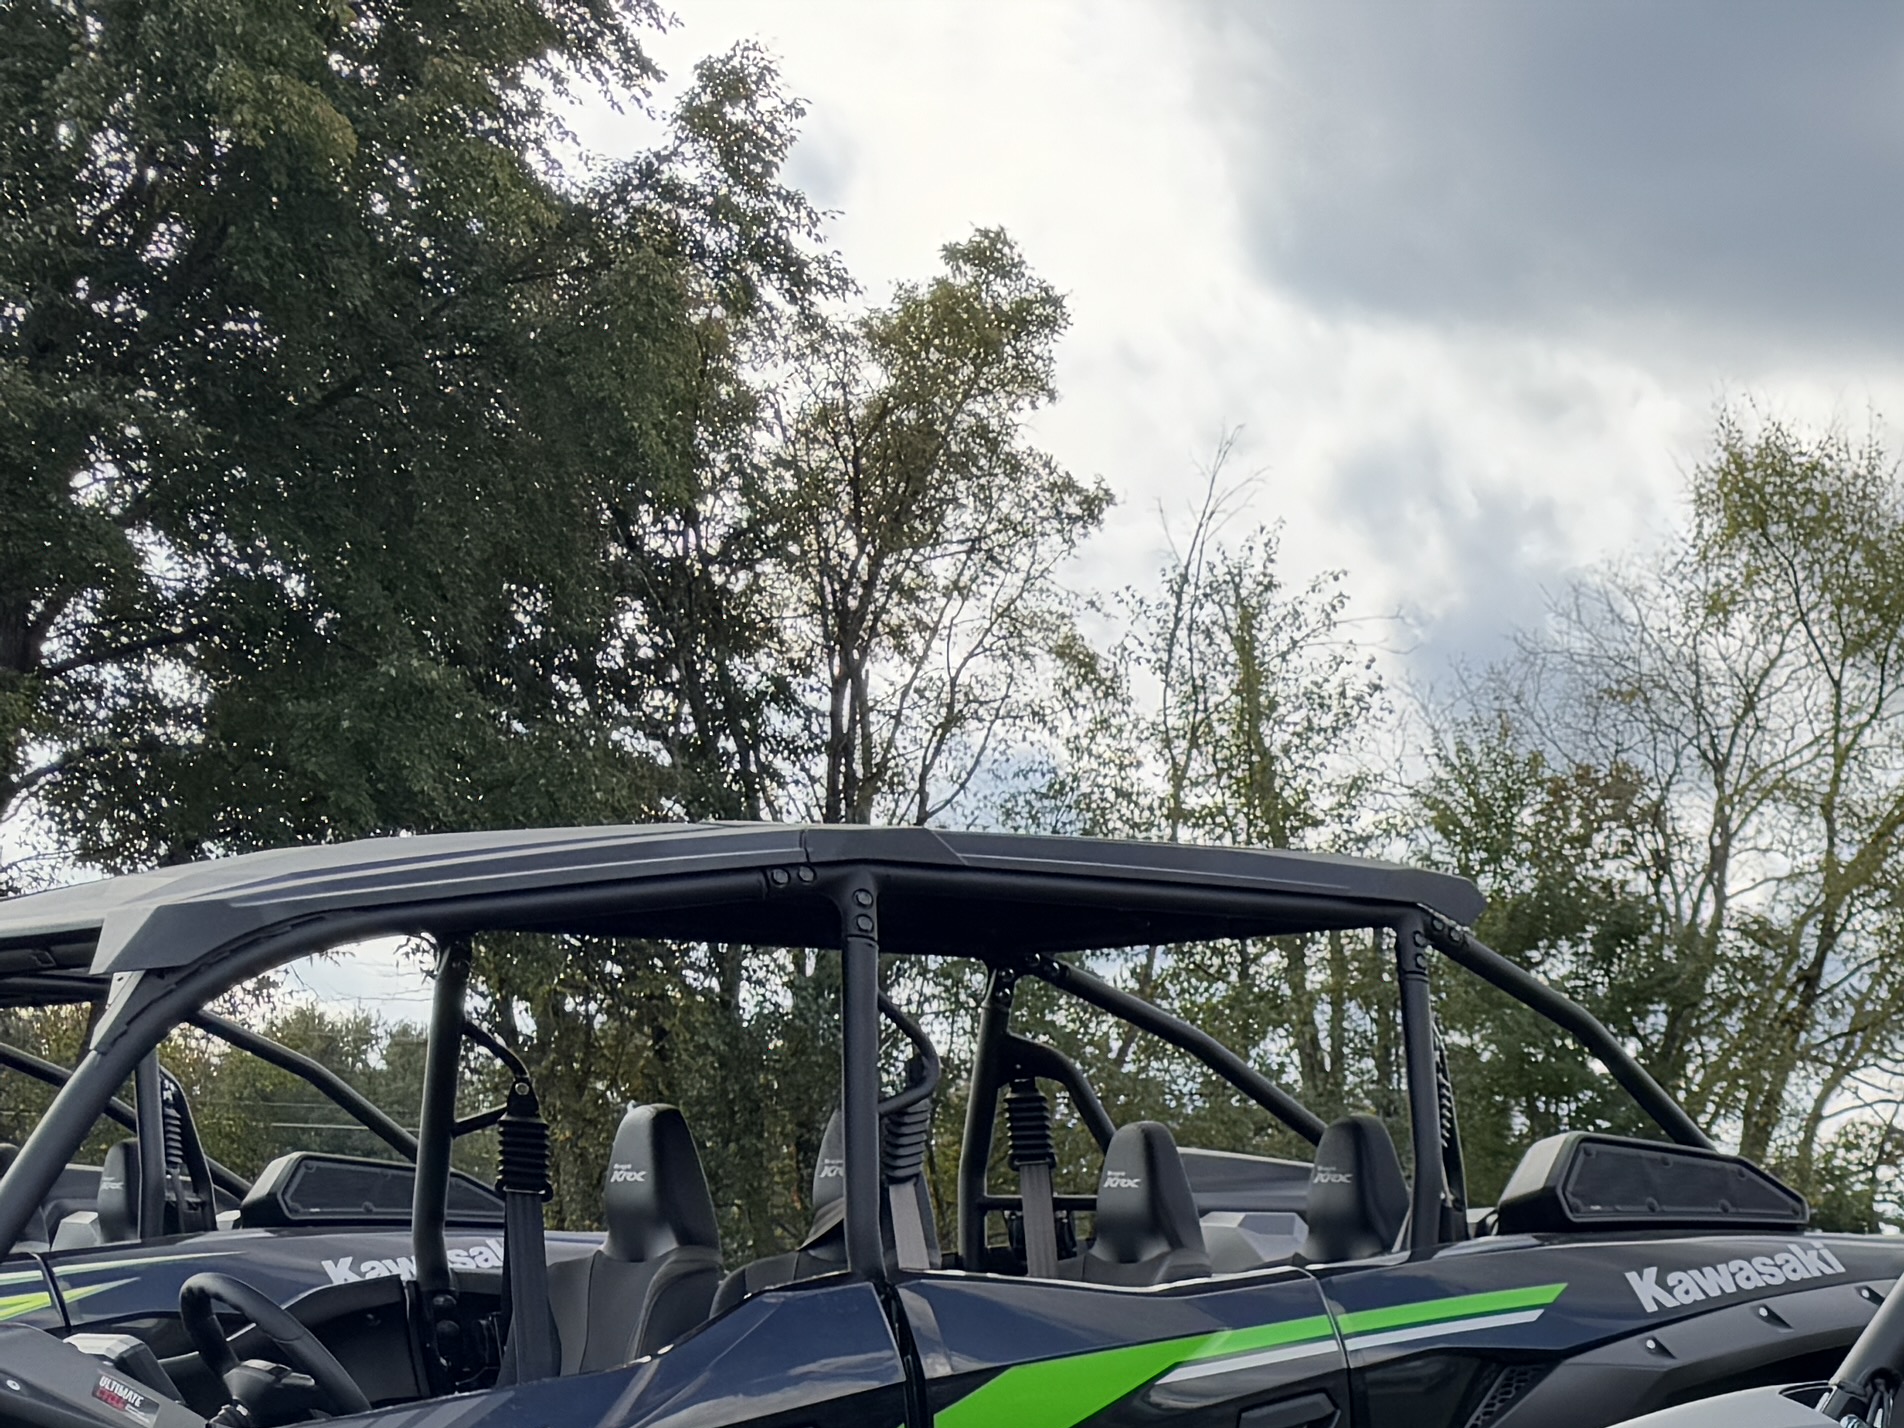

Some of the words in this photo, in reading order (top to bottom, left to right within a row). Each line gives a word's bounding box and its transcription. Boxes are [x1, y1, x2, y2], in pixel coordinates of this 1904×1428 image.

[321, 1238, 504, 1285] Kawsa
[1624, 1241, 1846, 1313] Kawasaki
[99, 1375, 145, 1408] ULTIMATE
